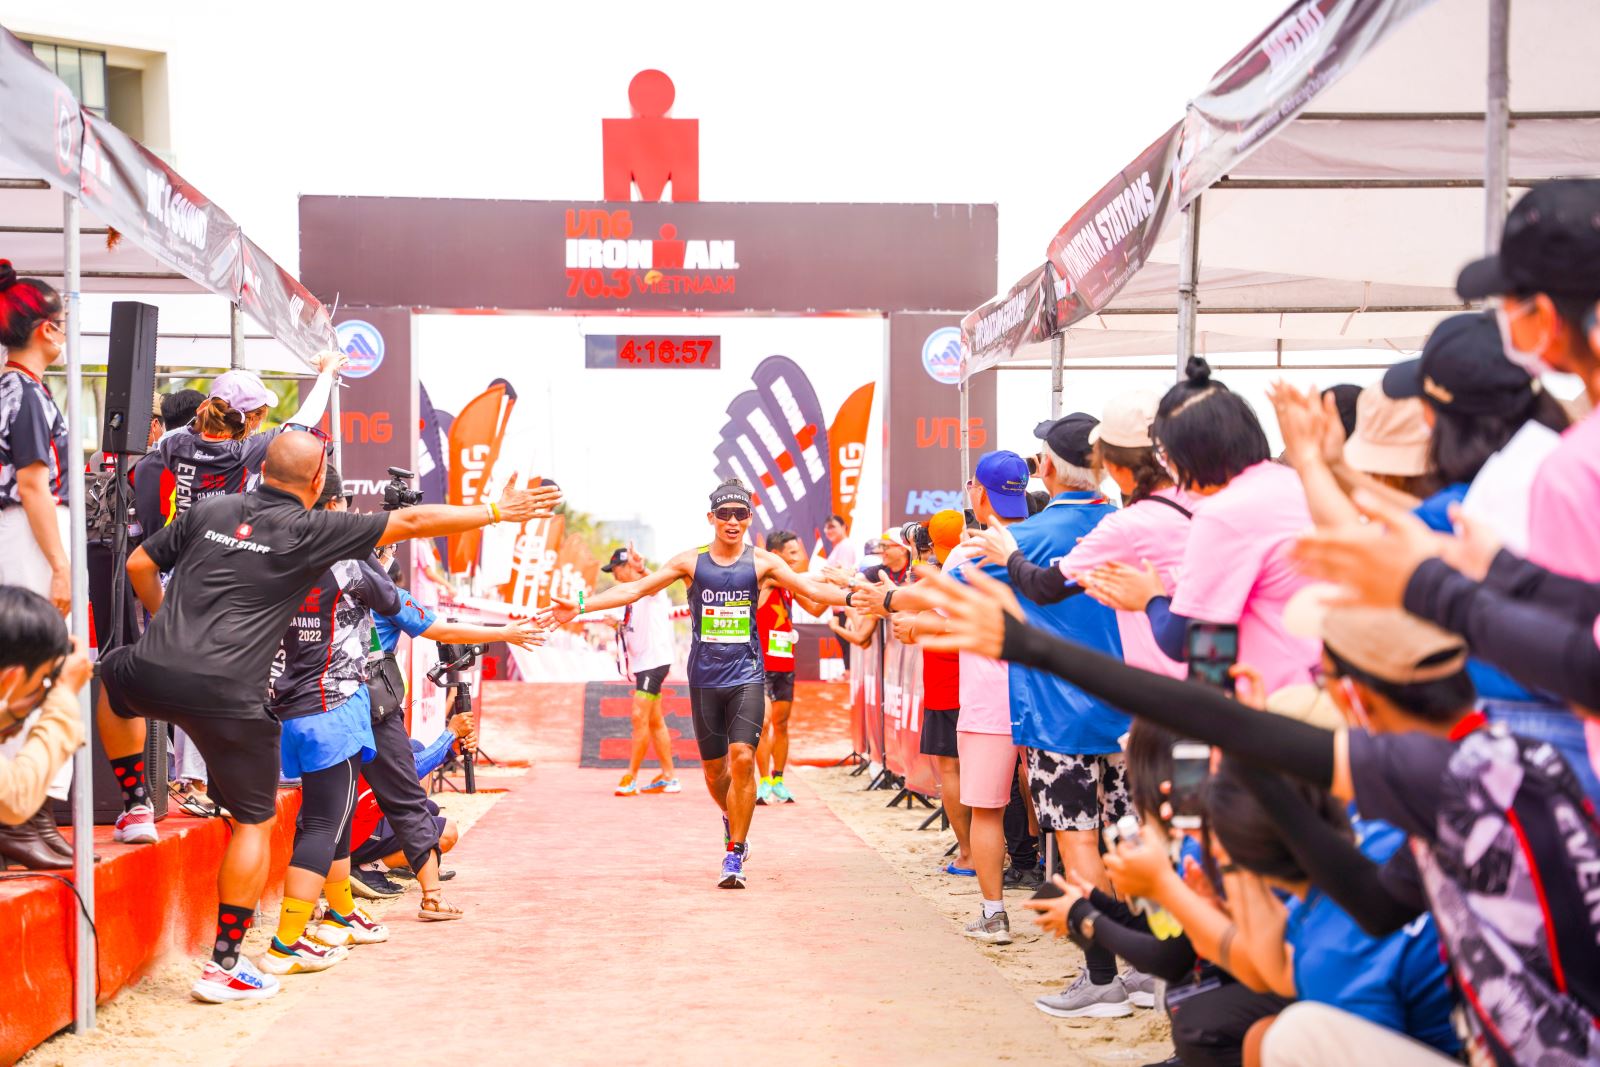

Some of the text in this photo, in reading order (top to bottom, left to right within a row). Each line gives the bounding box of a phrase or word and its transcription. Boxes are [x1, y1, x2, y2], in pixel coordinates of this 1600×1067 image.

[566, 208, 633, 239] VNG
[1095, 170, 1155, 251] STATIONS
[565, 223, 736, 269] IRONMAN
[566, 269, 736, 299] 70.3 VIETNAM
[904, 490, 964, 515] HOK
[204, 529, 271, 555] EVENT STAFF
[298, 630, 322, 642] 2022
